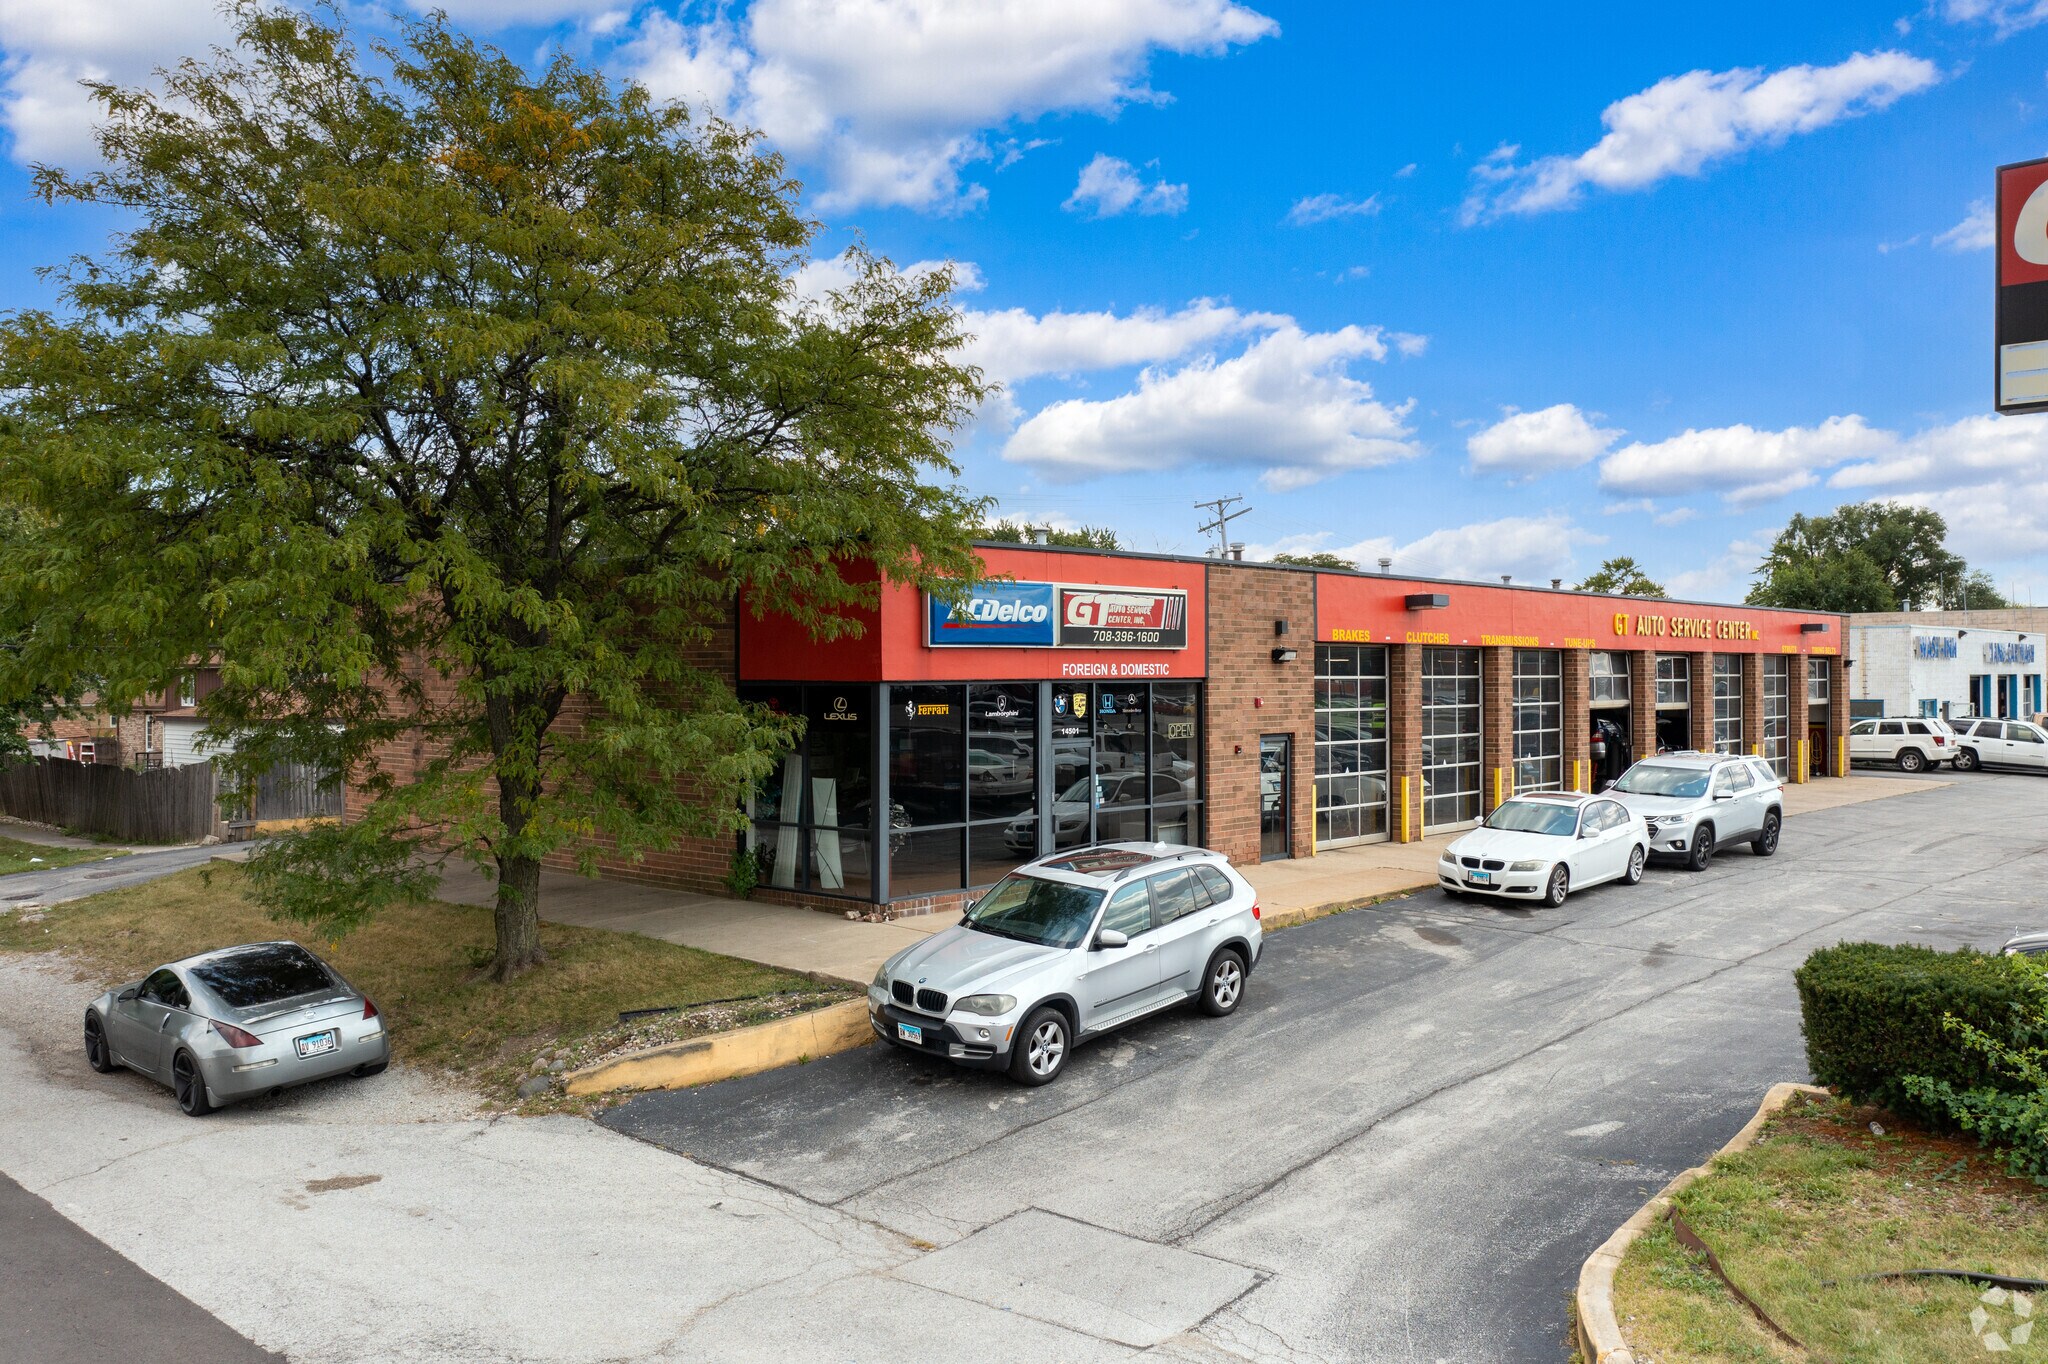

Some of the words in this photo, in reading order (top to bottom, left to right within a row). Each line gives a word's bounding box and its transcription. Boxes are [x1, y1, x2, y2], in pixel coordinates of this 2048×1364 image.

[1067, 594, 1155, 626] GT
[1613, 613, 1630, 636] GT
[1636, 614, 1666, 637] AUTO
[1670, 616, 1712, 639] SERVICE
[1716, 619, 1751, 641] CENTER
[1093, 631, 1159, 642] 708-396-1600
[1331, 628, 1370, 641] BRAKES
[1406, 631, 1450, 644] CLUTCHES
[1481, 634, 1539, 647] TRANSMISSIONS
[1564, 637, 1596, 648] TUNE-UPS
[1062, 663, 1108, 676] FOREIGN
[1111, 664, 1118, 676] &
[1120, 663, 1170, 676] DOMESTIC
[918, 704, 949, 715] Ferrari
[1062, 727, 1079, 735] 14501
[1170, 724, 1192, 737] OPEN
[312, 1037, 331, 1047] 91036
